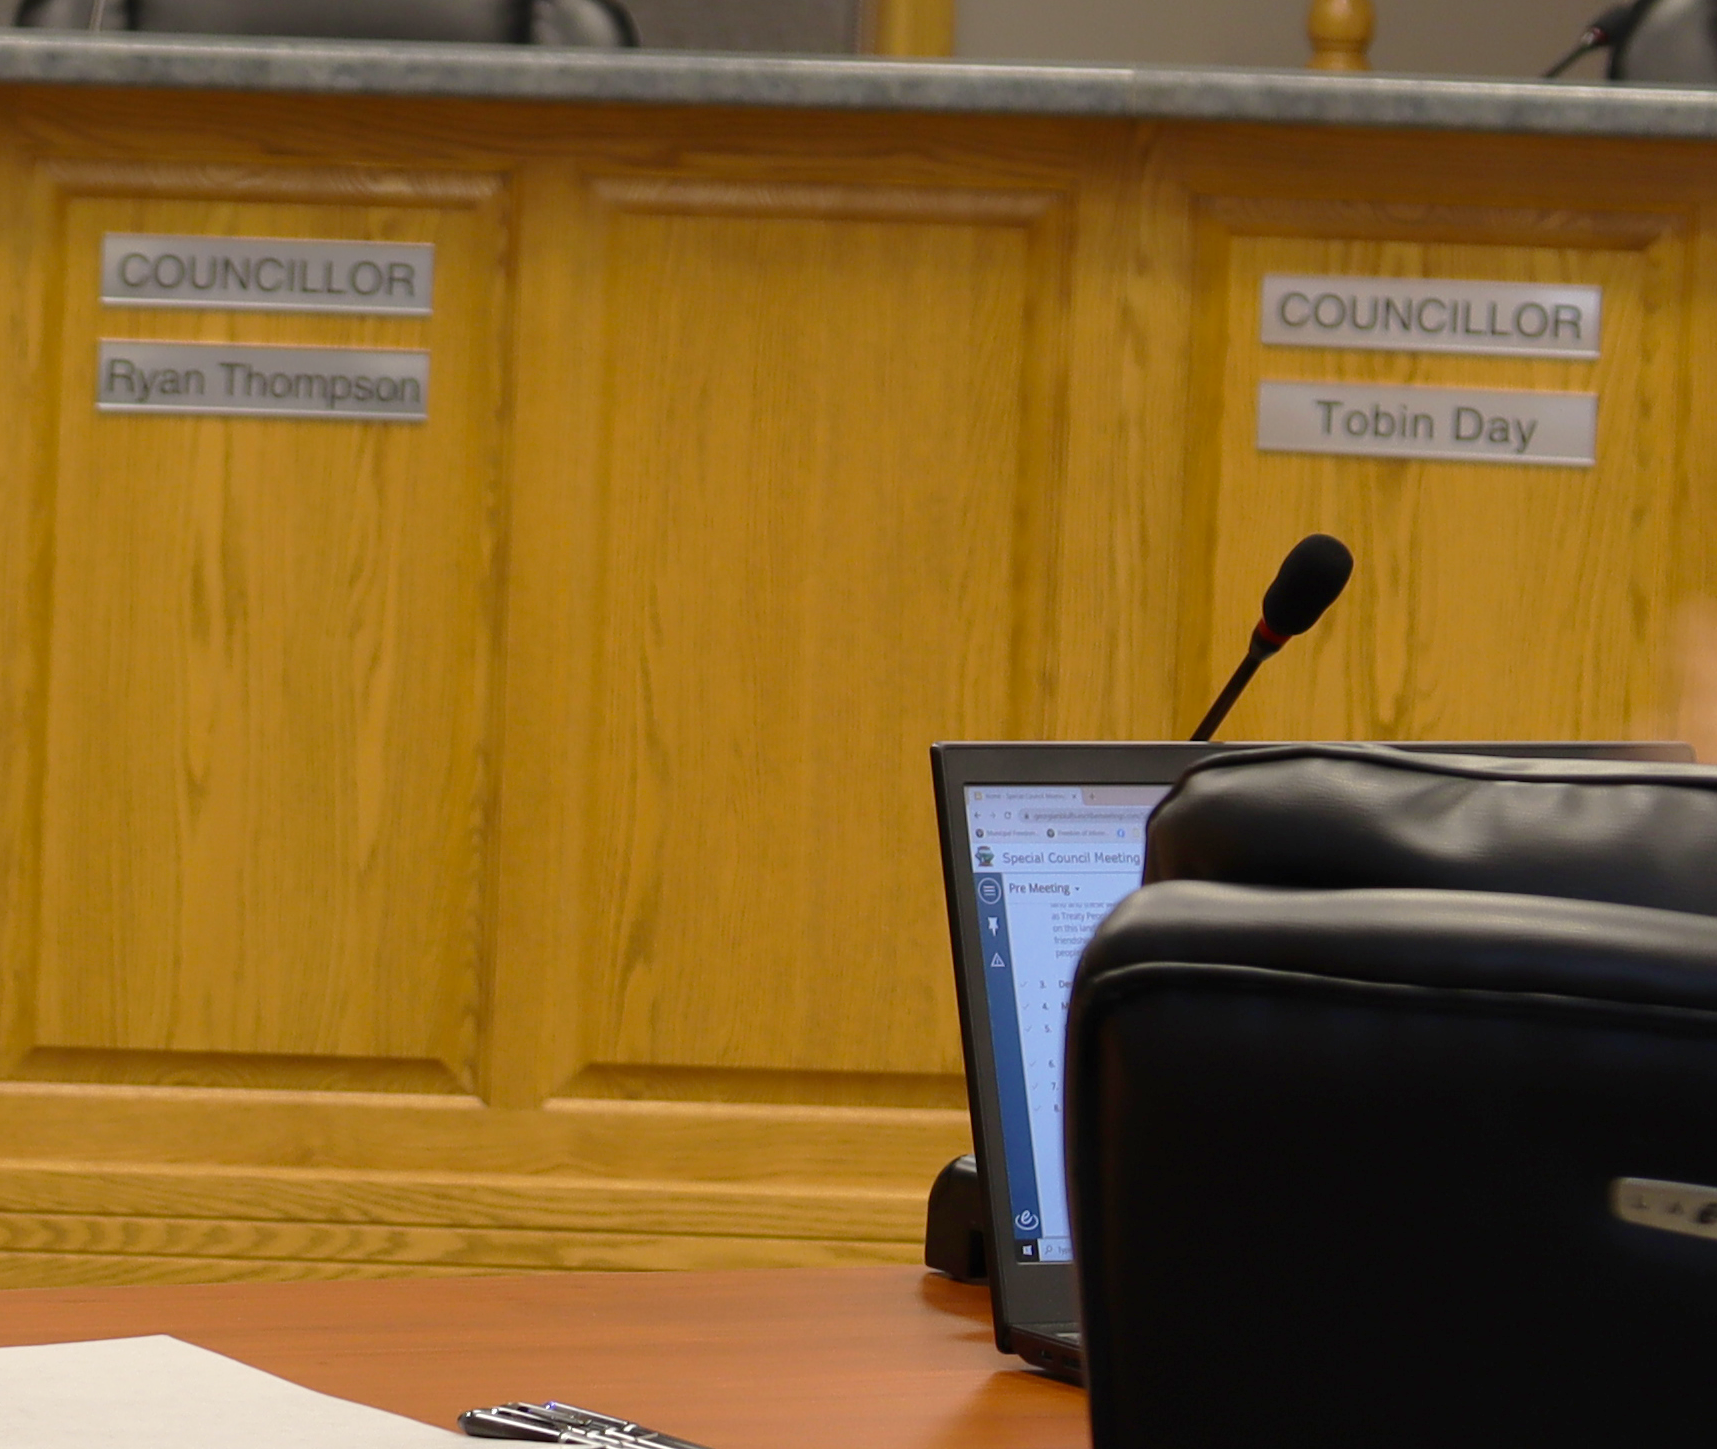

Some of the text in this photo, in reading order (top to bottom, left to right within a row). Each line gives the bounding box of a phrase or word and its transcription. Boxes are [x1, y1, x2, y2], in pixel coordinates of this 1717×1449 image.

[120, 252, 416, 297] COUNCILLOR
[1280, 291, 1583, 340] COUNCILLOR
[106, 358, 421, 409] Ryan Thompson
[1316, 399, 1539, 454] Tobin Day
[1002, 852, 1141, 866] Special Council Meeting
[1009, 882, 1071, 896] Pre Meeting
[1061, 912, 1085, 923] Treaty
